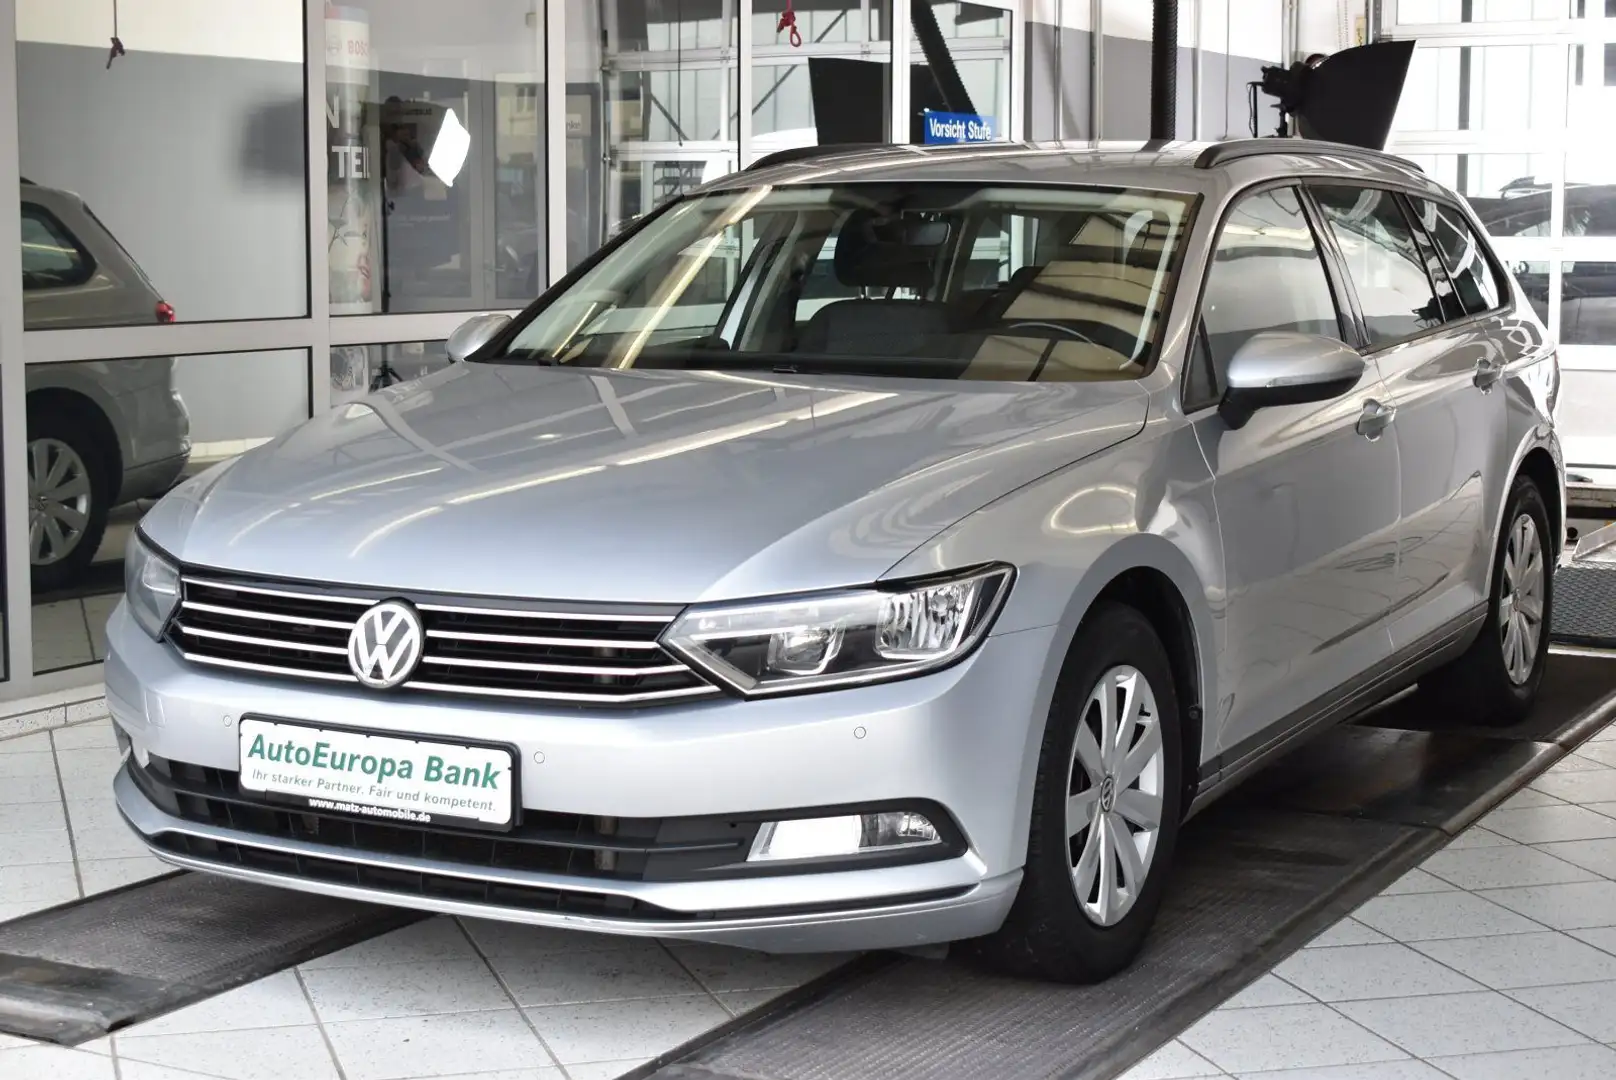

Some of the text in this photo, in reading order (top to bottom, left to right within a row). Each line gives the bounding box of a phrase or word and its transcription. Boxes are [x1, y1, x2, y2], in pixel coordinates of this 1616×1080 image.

[929, 118, 992, 140] Vorsicht Stufe
[247, 733, 501, 789] AutoEuropa Bank
[252, 768, 497, 812] Ihr starker Partner. Fair und kompetent.
[308, 798, 432, 823] www.matz-automobile.de
